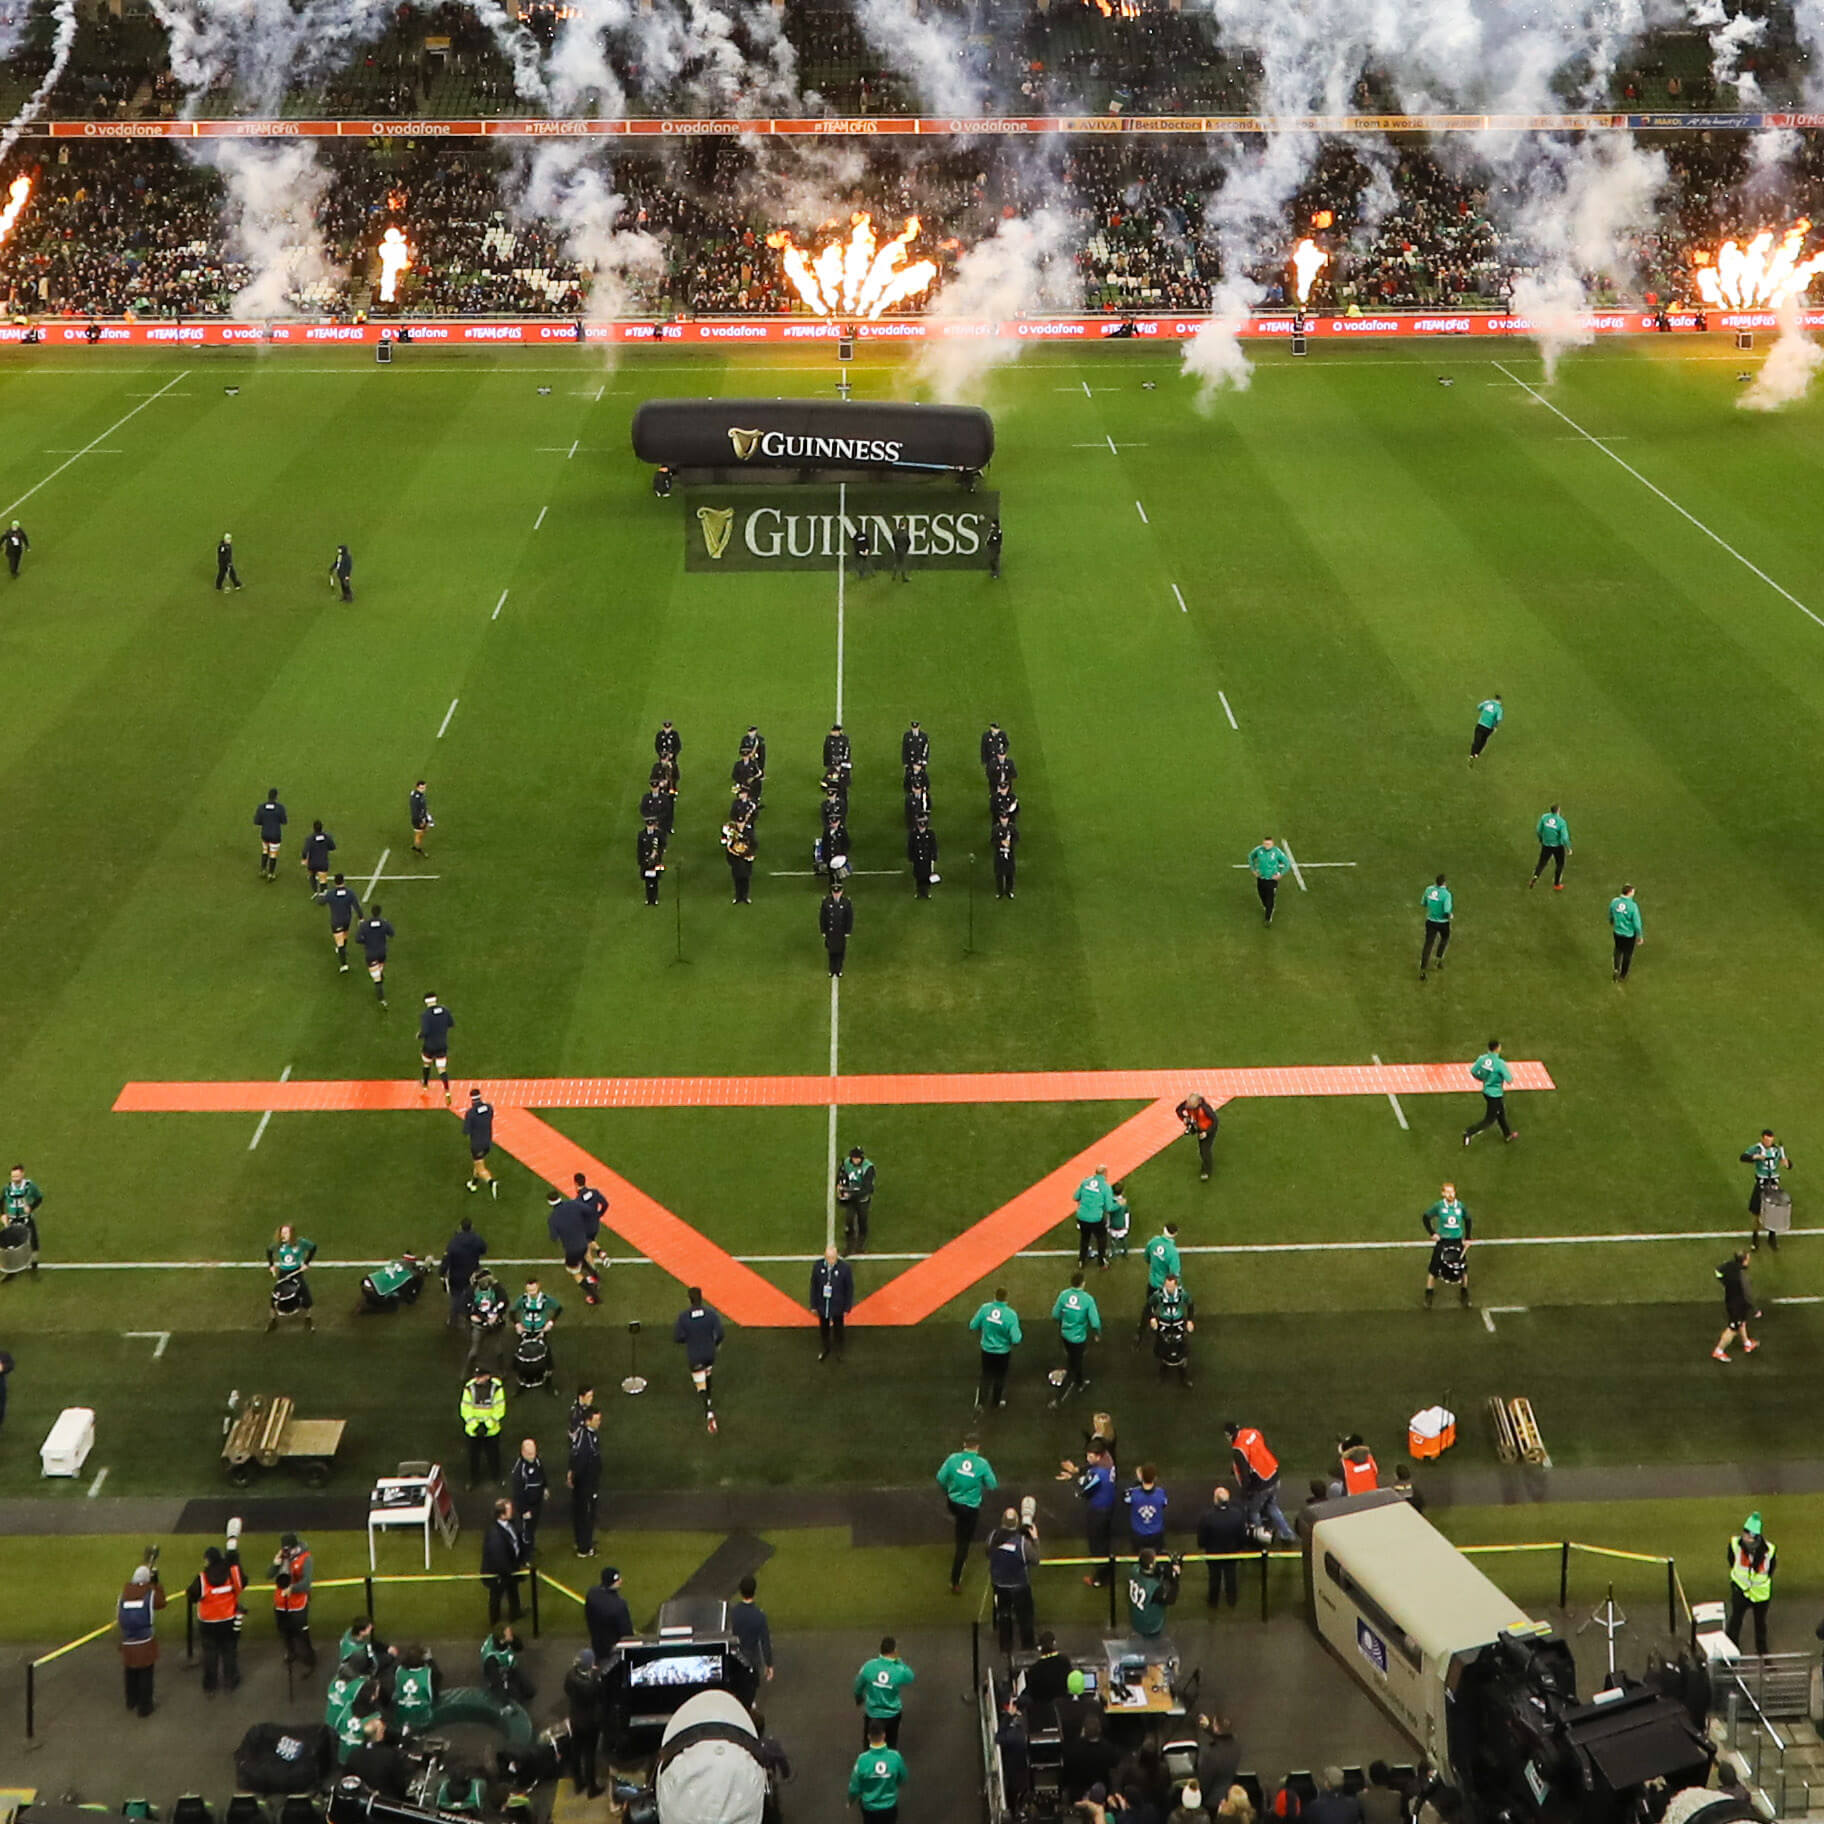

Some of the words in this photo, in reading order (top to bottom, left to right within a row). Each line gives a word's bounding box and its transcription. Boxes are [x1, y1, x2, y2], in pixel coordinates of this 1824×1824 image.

[676, 122, 739, 133] vodafone
[965, 121, 1028, 132] vodafone
[1080, 121, 1118, 130] AVIVA
[1136, 121, 1159, 130] Best
[1161, 121, 1202, 130] Doctors
[1215, 118, 1253, 128] second
[1355, 118, 1380, 128] from
[1383, 120, 1389, 128] a
[1393, 118, 1423, 128] world
[98, 124, 162, 136] vodafone
[386, 123, 450, 135] vodafone
[712, 326, 766, 337] vodafone
[871, 325, 925, 336] vodafone
[1029, 324, 1085, 336] vodafone
[1343, 321, 1398, 332] vodafone
[761, 432, 903, 462] GUINNESS
[745, 507, 982, 558] GUINNESS
